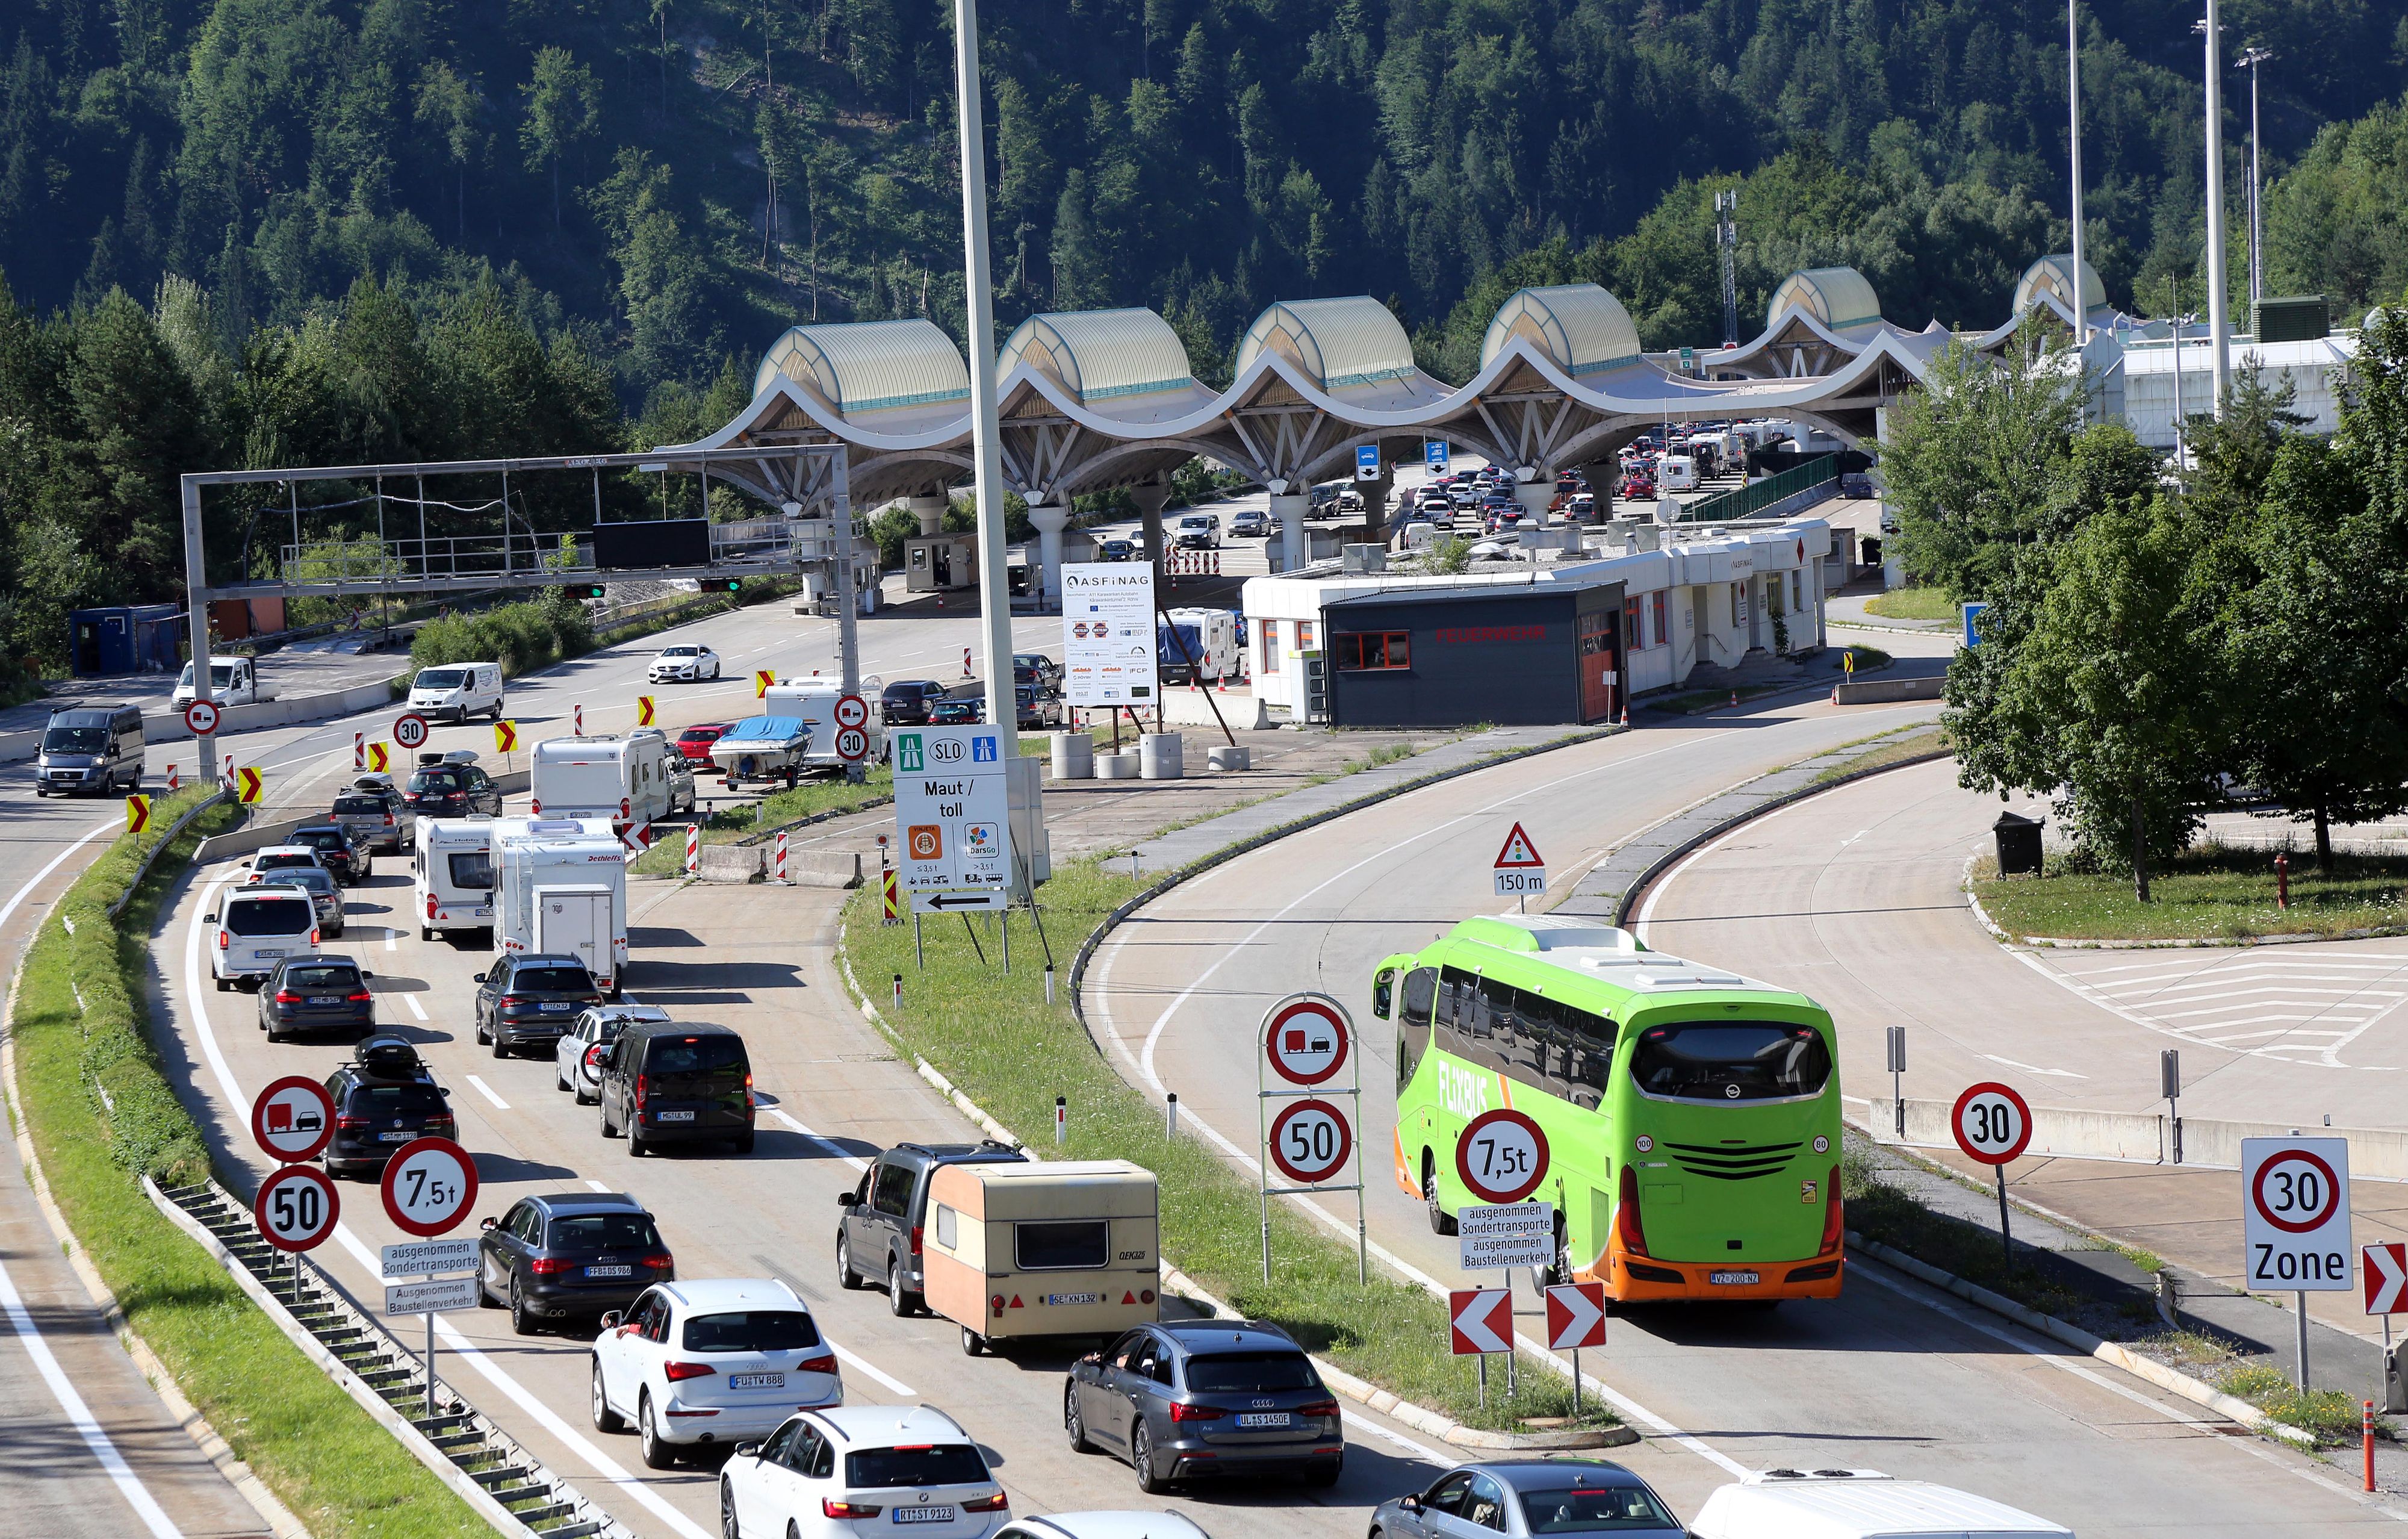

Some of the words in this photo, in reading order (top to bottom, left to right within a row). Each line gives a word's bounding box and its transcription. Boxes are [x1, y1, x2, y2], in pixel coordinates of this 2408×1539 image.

[1436, 626, 1546, 643] FEUERWEHR
[402, 723, 418, 740] 30
[843, 735, 860, 751] 30
[936, 742, 960, 760] SLO
[925, 781, 963, 796] Maut
[967, 779, 974, 797] /
[940, 802, 963, 817] toll
[1498, 874, 1524, 890] 150
[1529, 877, 1542, 889] m
[552, 904, 562, 913] 100
[1971, 1103, 2009, 1143] 30
[1291, 1122, 1333, 1161] 50
[2274, 1172, 2318, 1212] 30
[275, 1186, 319, 1232] 50
[1469, 1206, 1542, 1220] ausgenommen
[1462, 1219, 1550, 1234] Sondertransporte
[392, 1242, 469, 1260] ausgenommen
[1473, 1238, 1542, 1253] ausgenommen
[383, 1256, 479, 1274] Sondertransporte
[1465, 1251, 1551, 1266] Baustellenverkehr
[2255, 1243, 2344, 1280] Zone
[396, 1283, 465, 1299] Ausgenommen
[389, 1296, 473, 1313] Baustellenverkehr
[1054, 1295, 1064, 1304] SE
[1069, 1295, 1079, 1303] KN
[1081, 1295, 1095, 1303] 132
[753, 1376, 764, 1385] TW
[766, 1375, 782, 1384] 888
[1241, 1416, 1252, 1425] UL
[1258, 1415, 1262, 1425] S
[1264, 1414, 1288, 1424] 1450E
[901, 1509, 911, 1520] RT
[918, 1509, 928, 1519] ST
[931, 1508, 952, 1519] 9123
